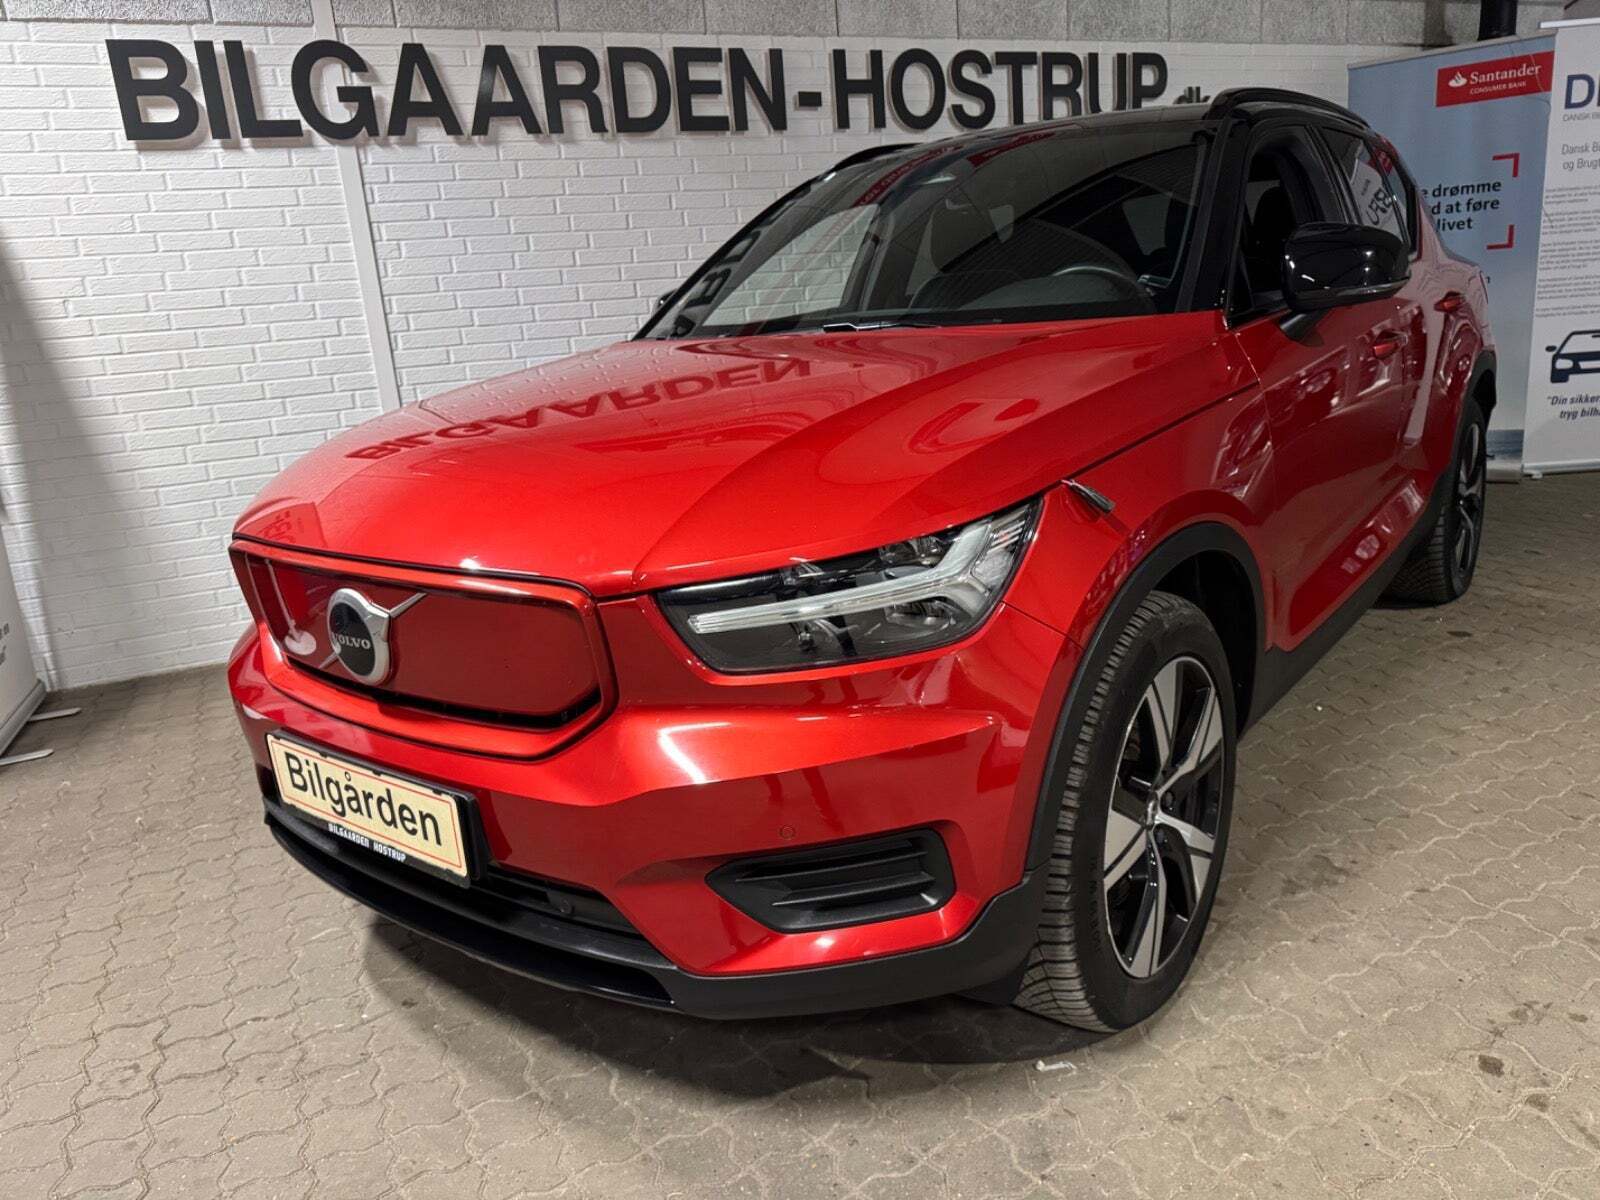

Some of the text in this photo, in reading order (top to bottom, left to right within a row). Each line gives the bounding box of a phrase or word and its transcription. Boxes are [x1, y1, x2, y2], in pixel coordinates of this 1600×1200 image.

[1470, 63, 1541, 85] Santander
[1470, 81, 1526, 95] CONSUMER BANK
[1561, 142, 1590, 155] Dansk
[1562, 160, 1575, 172] og
[1432, 181, 1501, 198] drømme
[1445, 200, 1462, 214] at
[1466, 198, 1500, 212] føre
[1436, 217, 1473, 232] livet
[1560, 410, 1579, 421] tryg
[285, 751, 442, 846] Bilgården
[328, 823, 406, 862] BILGAARDEN HOSTRUP
